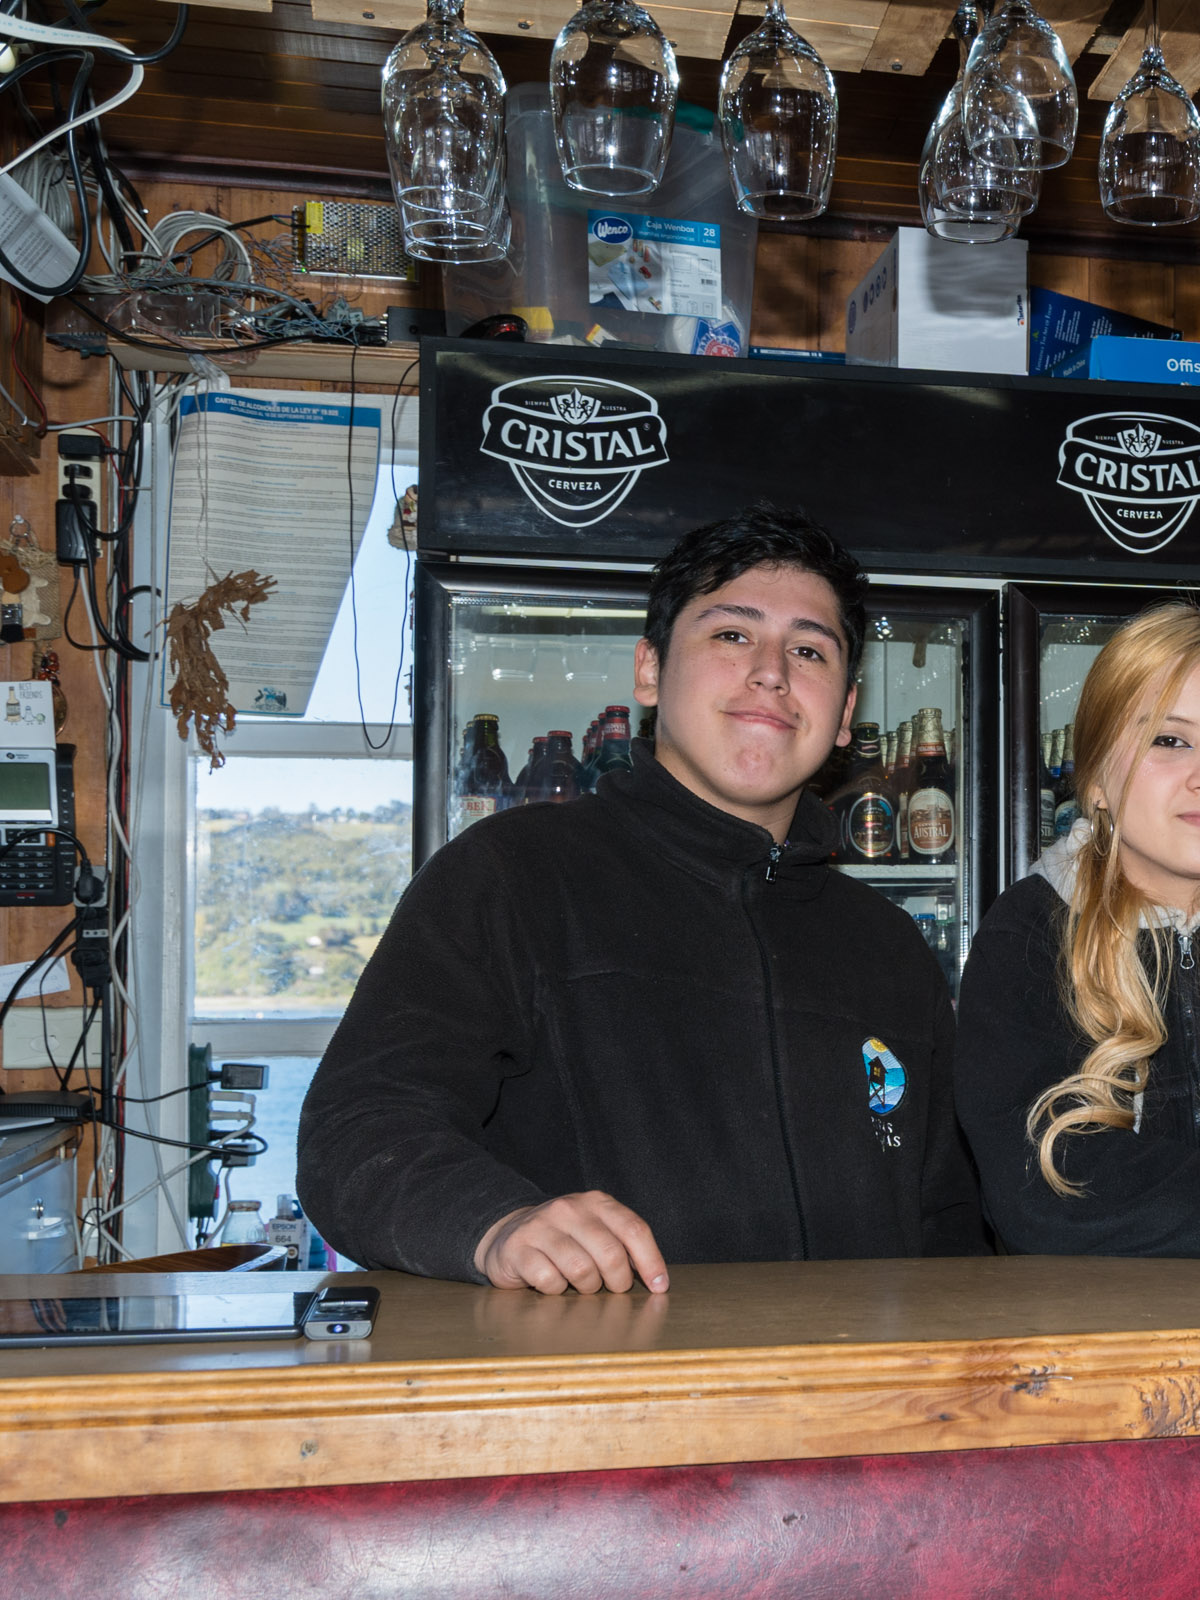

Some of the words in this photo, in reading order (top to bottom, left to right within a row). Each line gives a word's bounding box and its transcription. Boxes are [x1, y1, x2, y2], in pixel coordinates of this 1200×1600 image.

[598, 222, 628, 238] Wenco
[645, 220, 662, 231] Caja
[663, 223, 695, 233] Wenbox
[703, 227, 716, 237] 28
[524, 399, 549, 407] SIEMPRE
[601, 404, 627, 412] NUESTRA
[501, 418, 656, 462] CRISTAL
[1095, 434, 1117, 442] SIEMPRE
[1162, 438, 1184, 446] NUESTRA
[548, 478, 602, 491] CERVEZA
[1116, 508, 1163, 520] CERVEZA
[913, 826, 949, 839] AUSTRAL
[275, 1235, 292, 1243] 664
